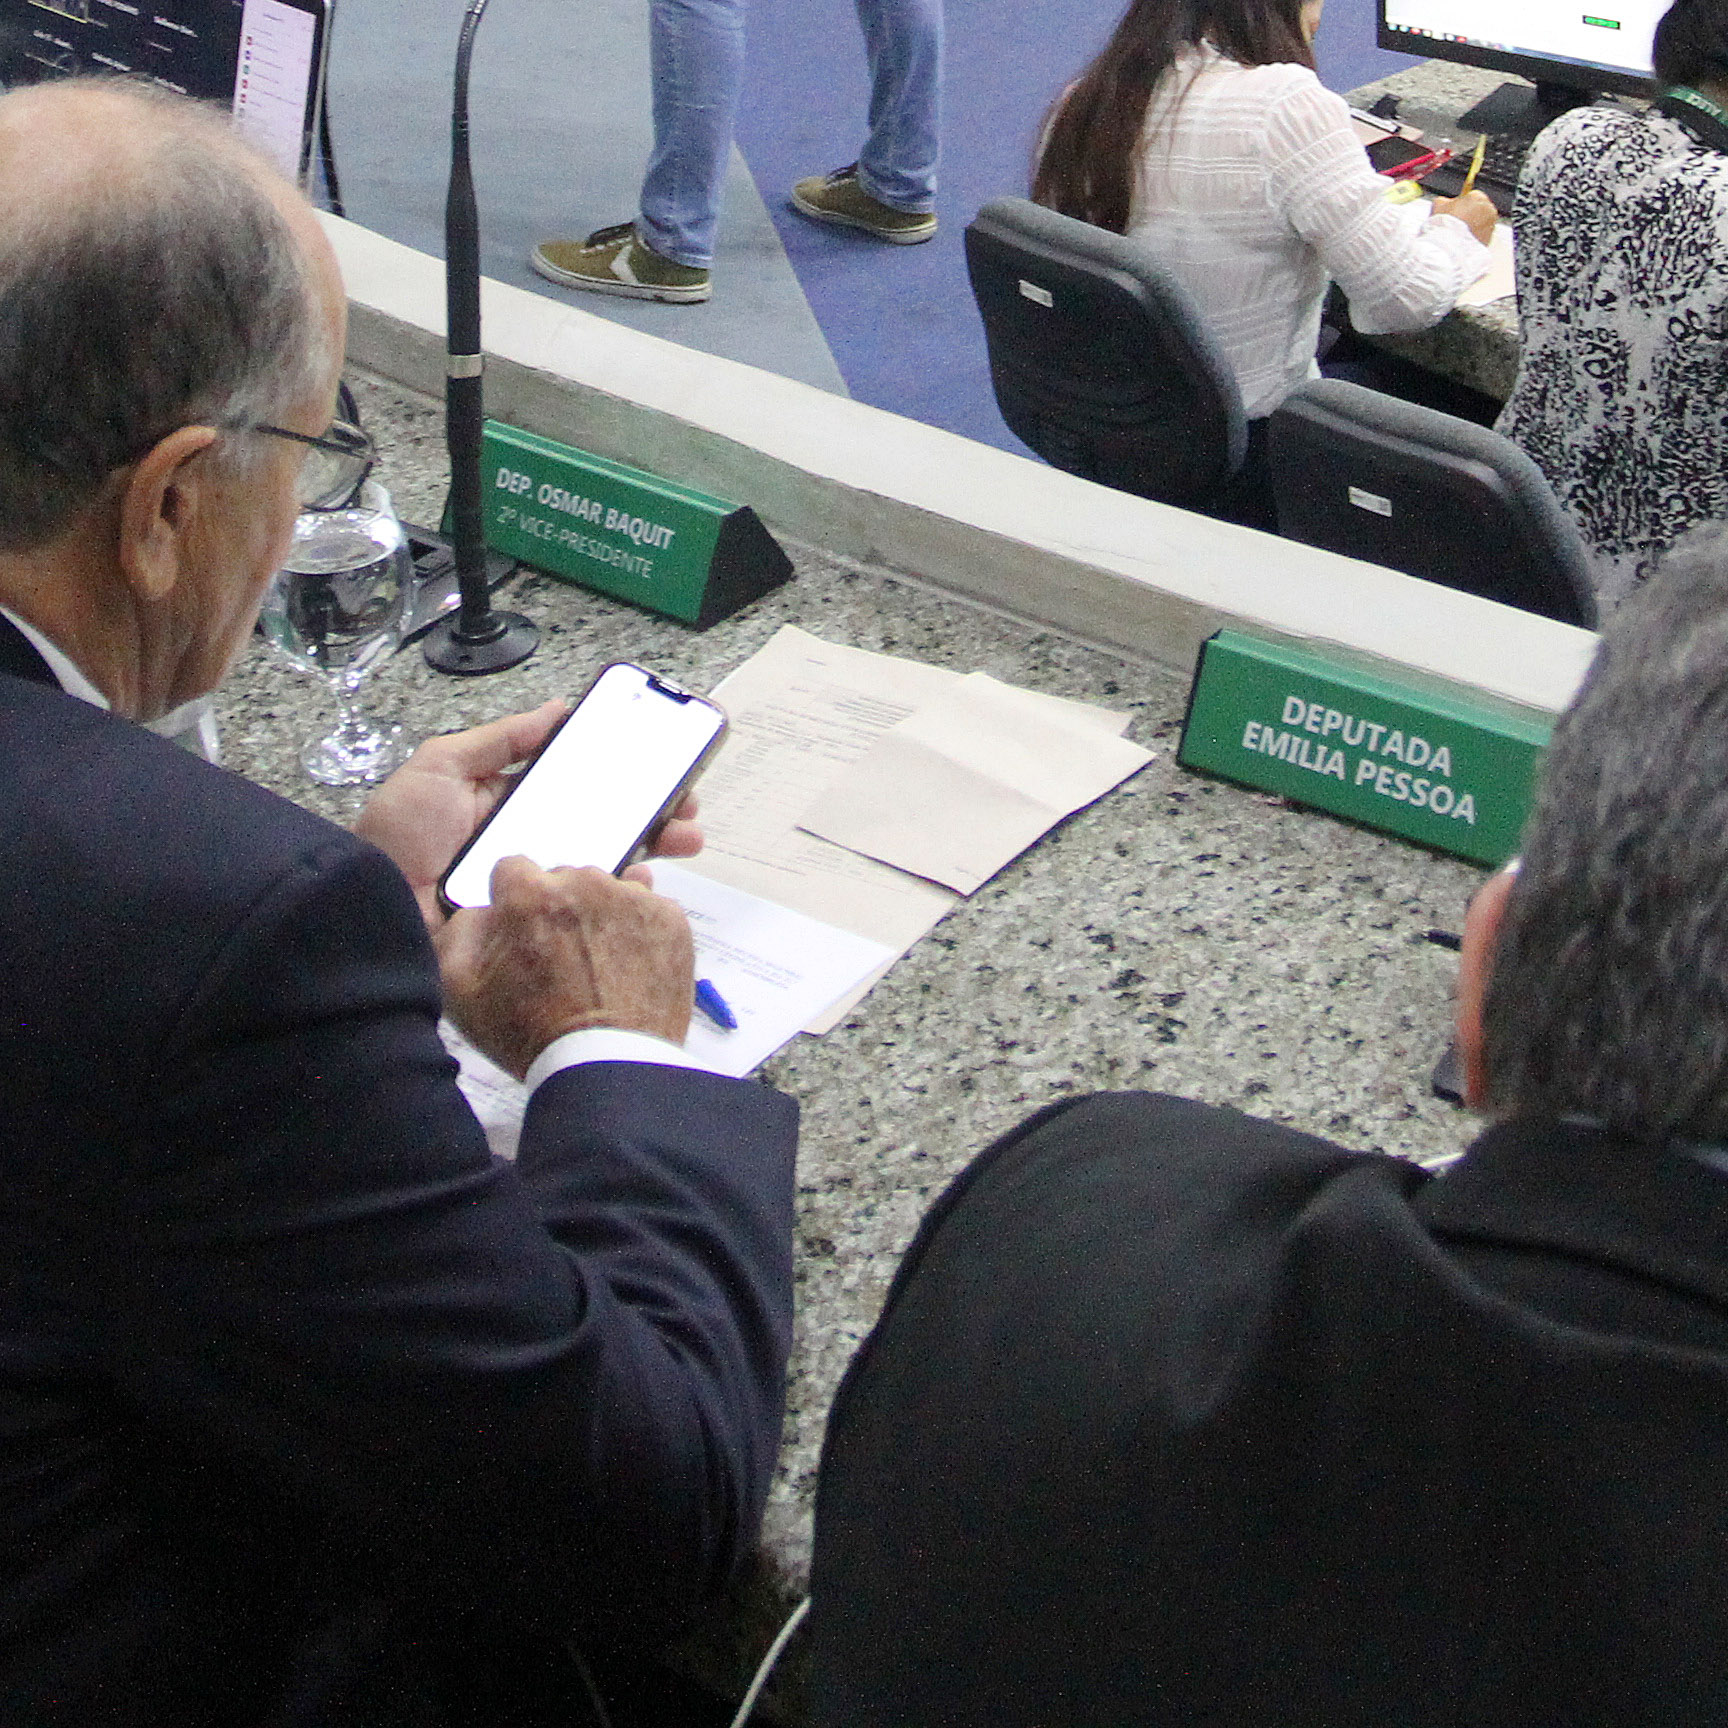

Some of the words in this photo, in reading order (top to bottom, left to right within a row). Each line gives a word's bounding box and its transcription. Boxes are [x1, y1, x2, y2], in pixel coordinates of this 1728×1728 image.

[495, 467, 534, 501] DEP.
[537, 483, 603, 524] OSMAR
[605, 508, 676, 550] BAQUIT
[520, 515, 654, 579] VICE-PRESIDENTE
[1241, 721, 1346, 781] EMILIA
[1355, 759, 1476, 825] PESSOA
[1281, 695, 1452, 778] DEPUTADA
